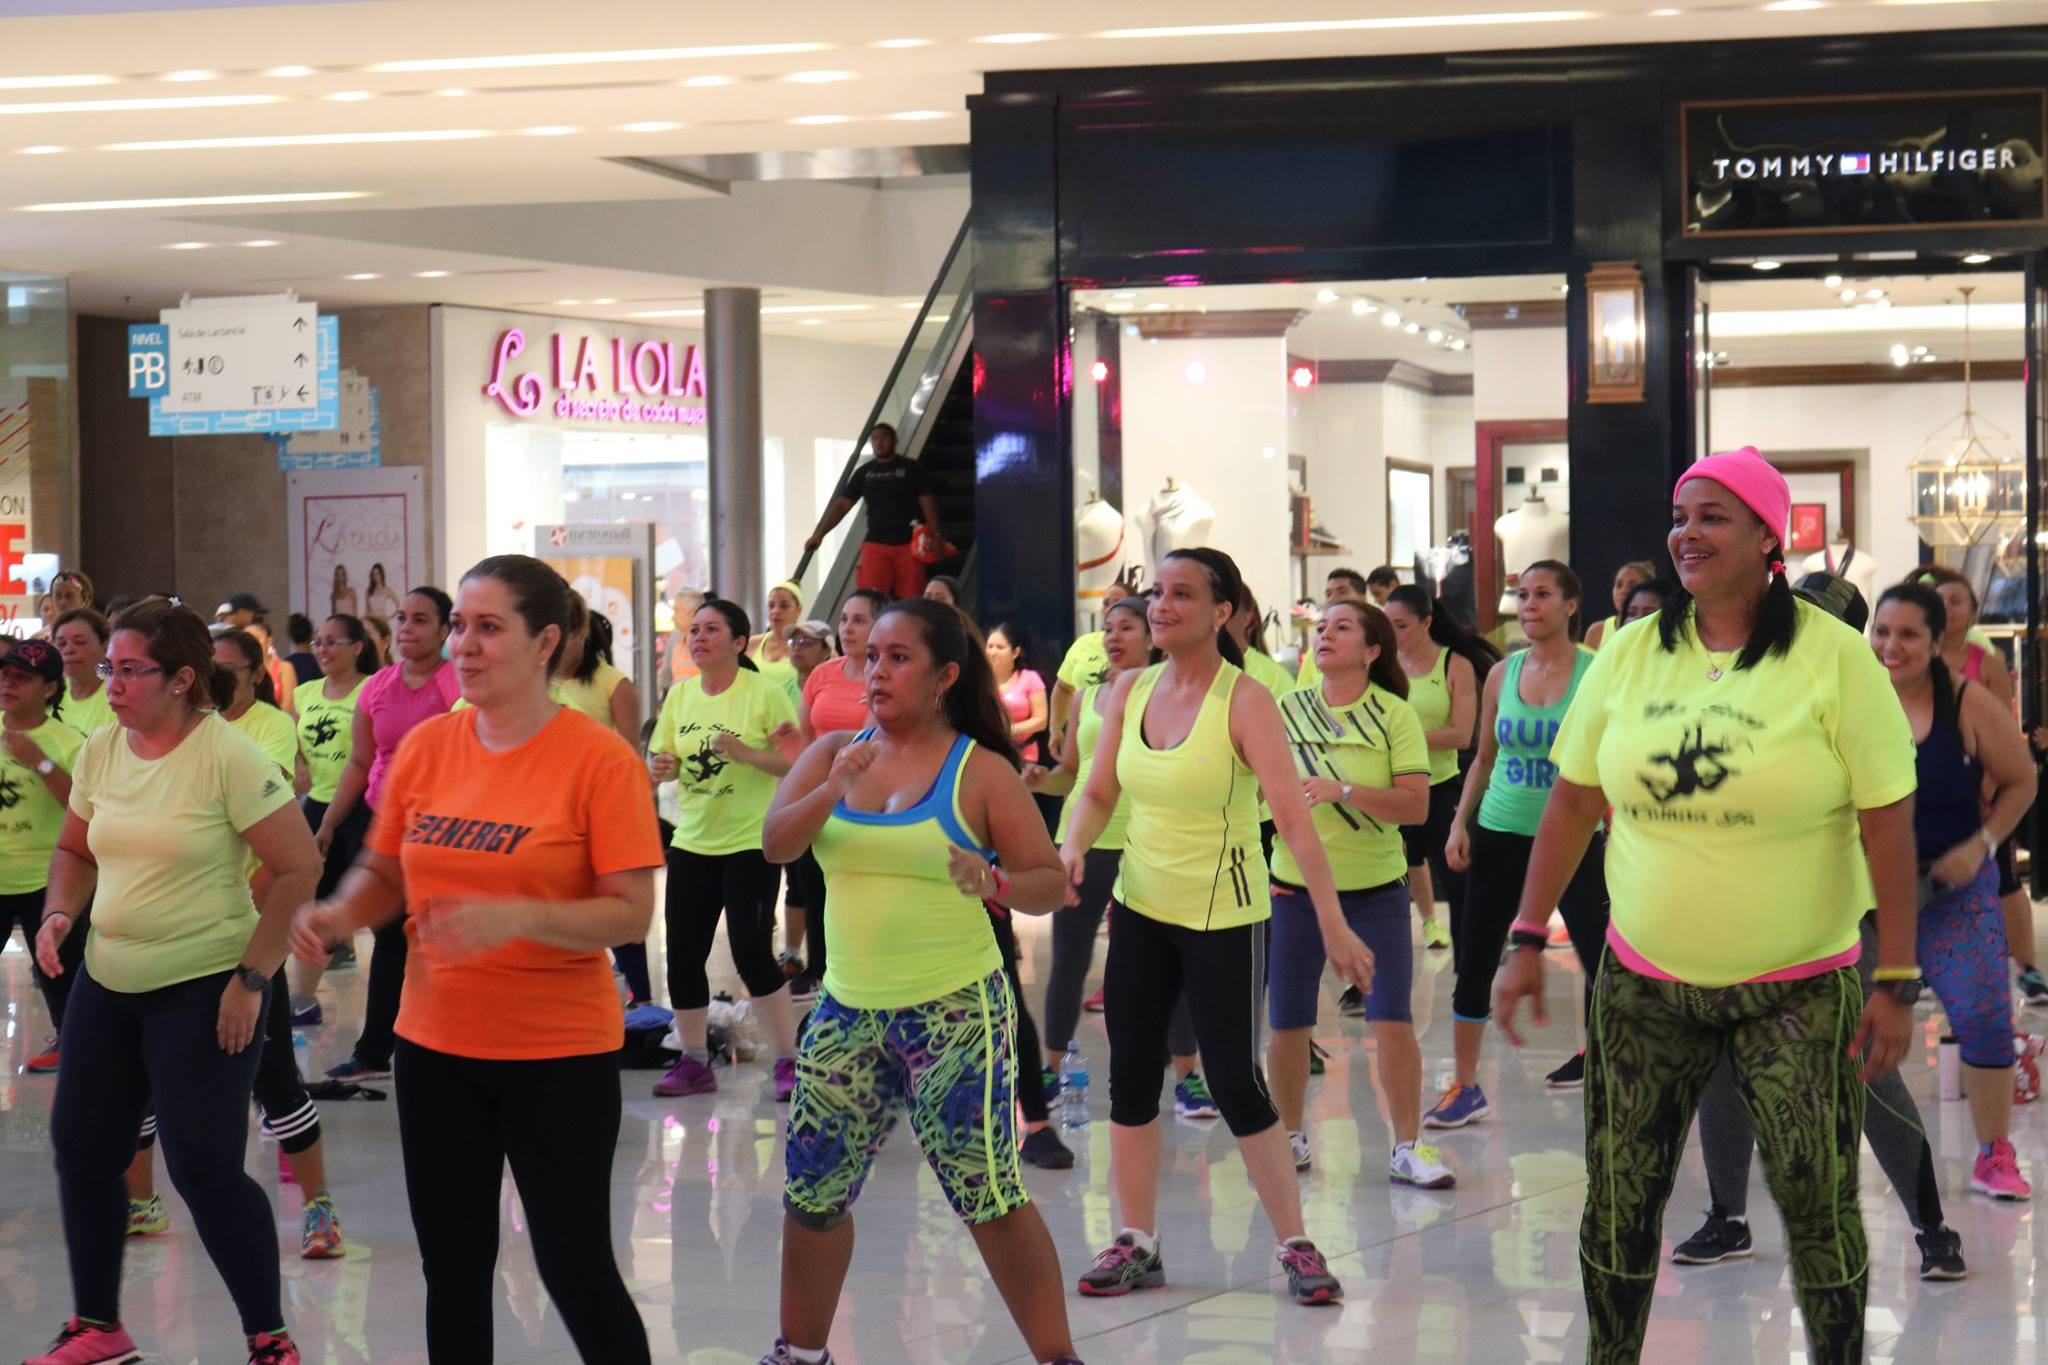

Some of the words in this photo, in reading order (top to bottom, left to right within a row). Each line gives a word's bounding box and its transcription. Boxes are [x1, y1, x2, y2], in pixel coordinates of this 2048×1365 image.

[1713, 154, 1834, 179] TOMMY
[1879, 148, 2016, 174] HILFIGER
[131, 333, 164, 346] NIVEL
[128, 351, 166, 390] PB
[552, 333, 598, 391] LA
[611, 337, 706, 397] LOLA
[183, 391, 202, 402] ATM
[570, 398, 617, 421] secreto
[620, 397, 640, 421] de
[1506, 756, 1560, 788] GIR
[421, 814, 533, 854] ENERGY
